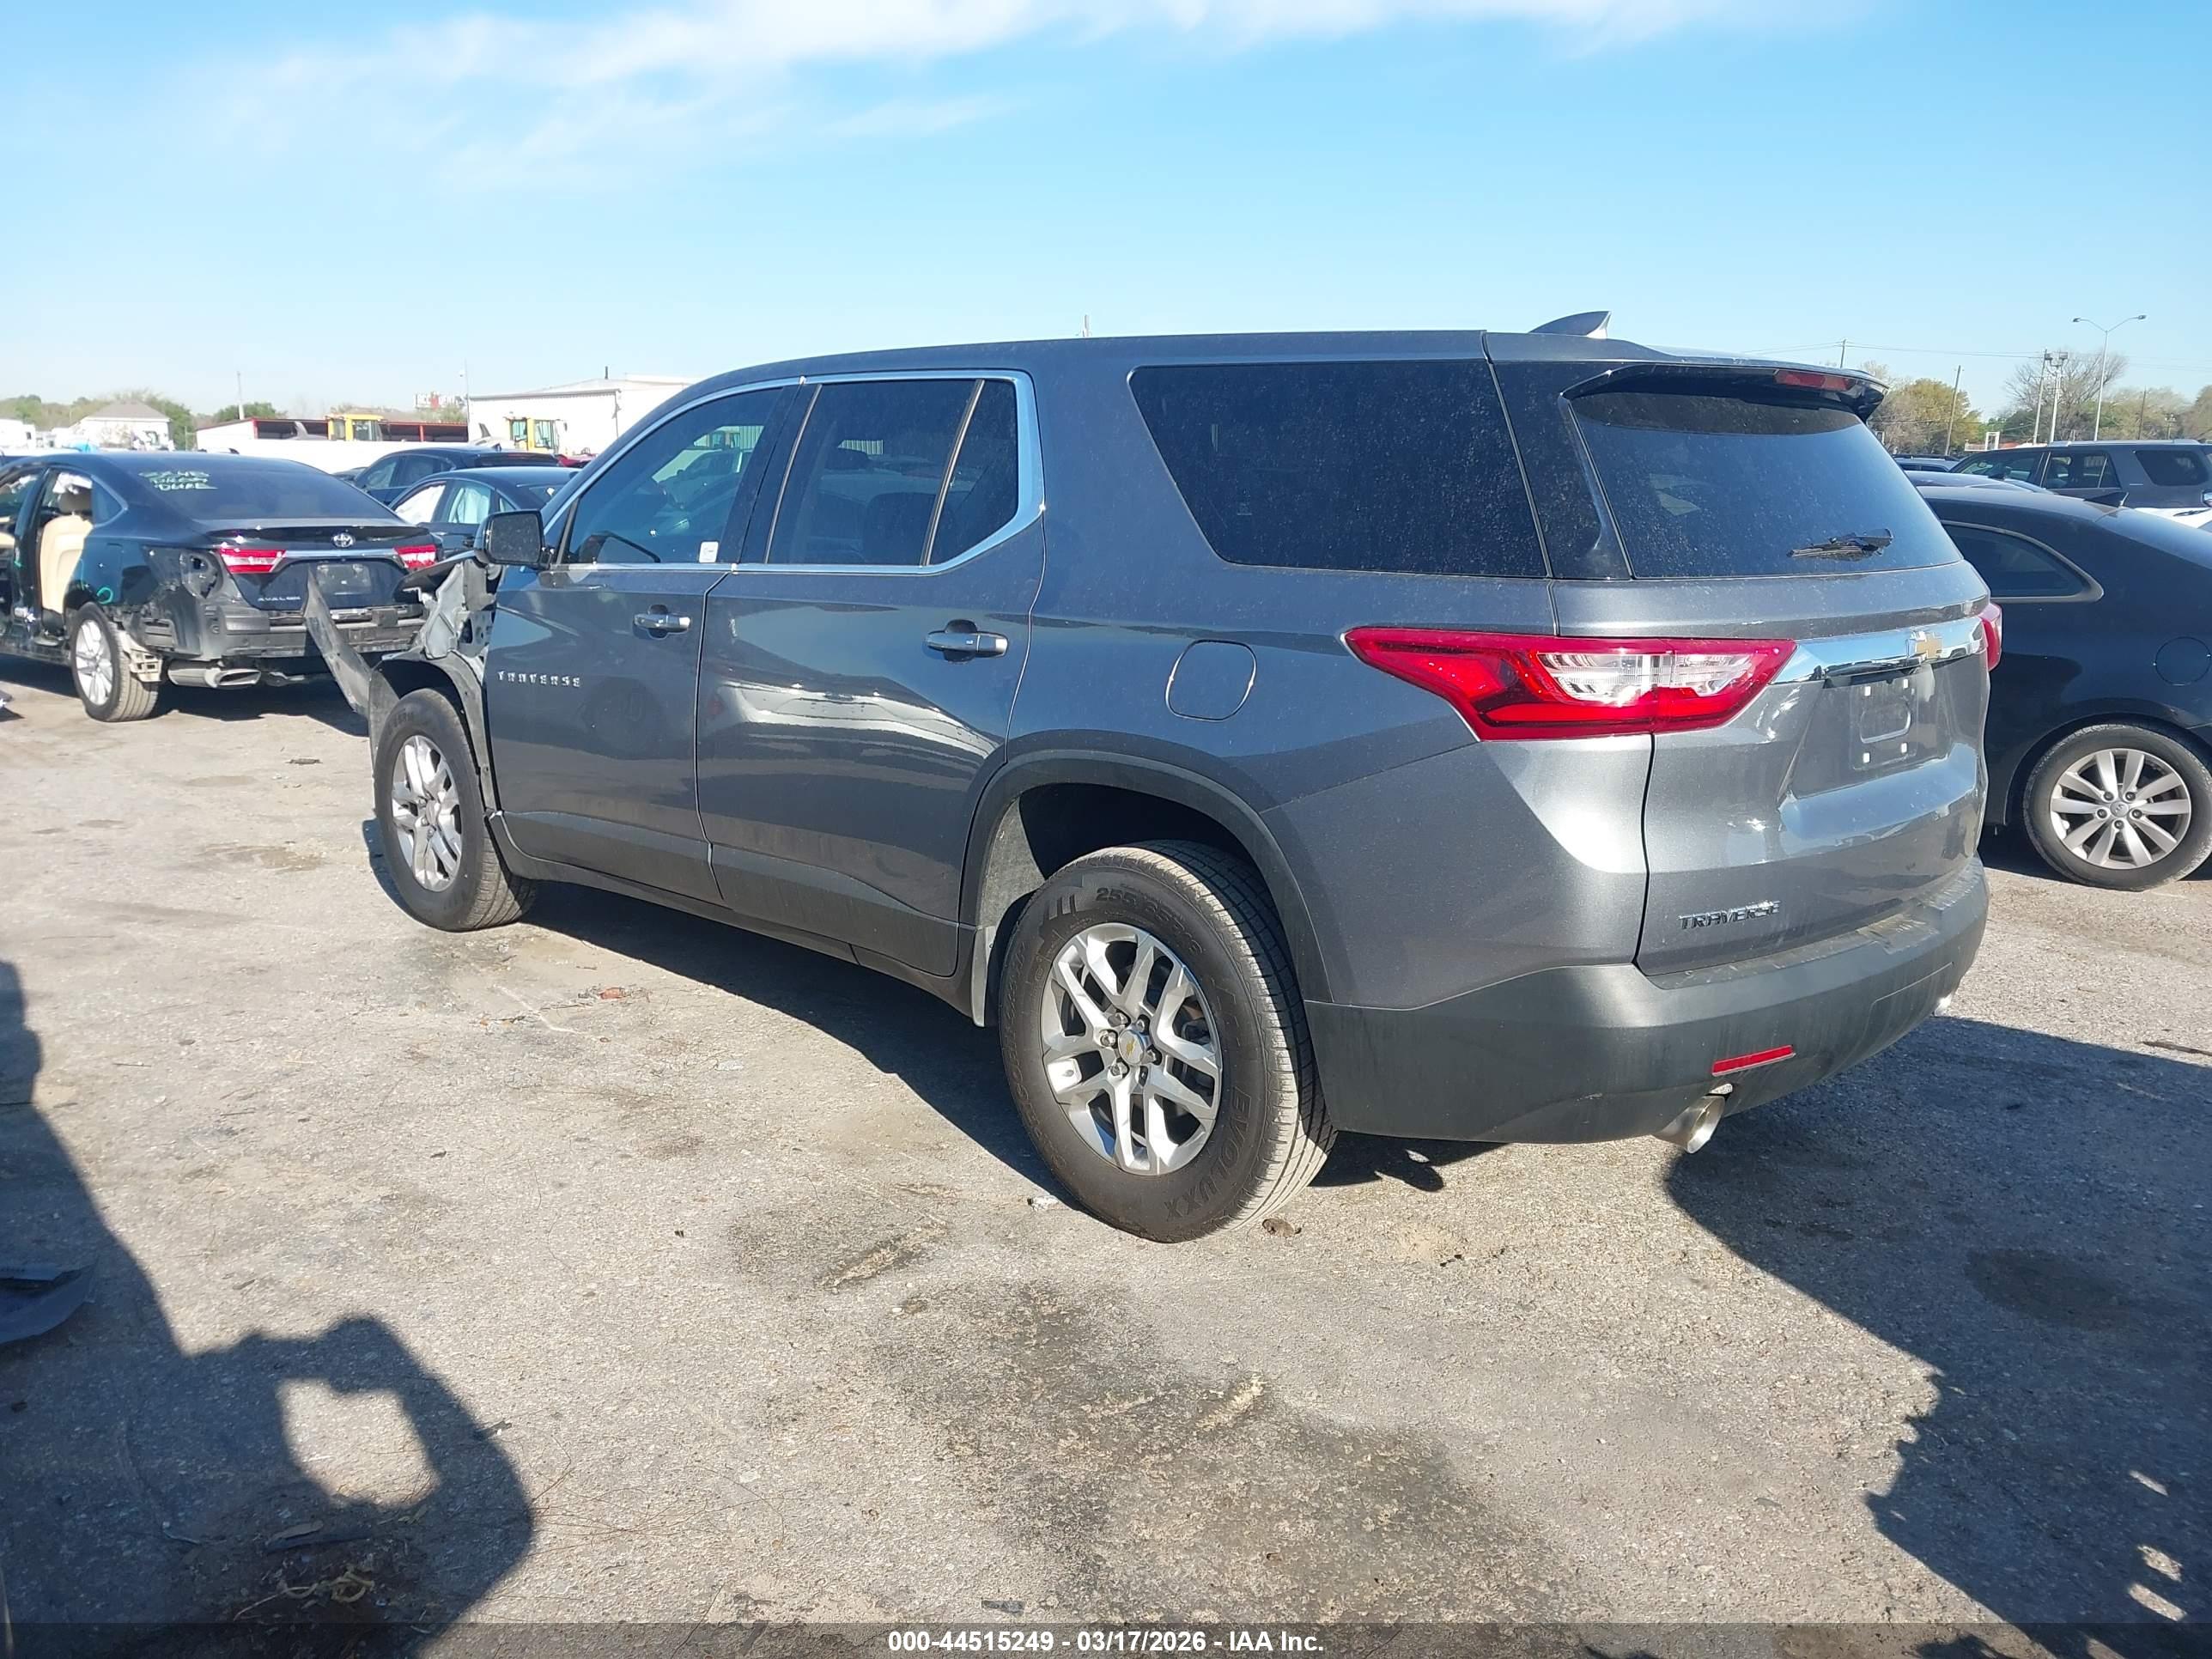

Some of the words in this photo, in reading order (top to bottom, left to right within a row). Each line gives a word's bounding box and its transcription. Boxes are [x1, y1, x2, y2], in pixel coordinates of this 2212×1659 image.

[497, 671, 580, 688] TRAVERSE
[1678, 900, 1780, 929] TRAVERSE
[1162, 1085, 1254, 1223] EVOLUXX
